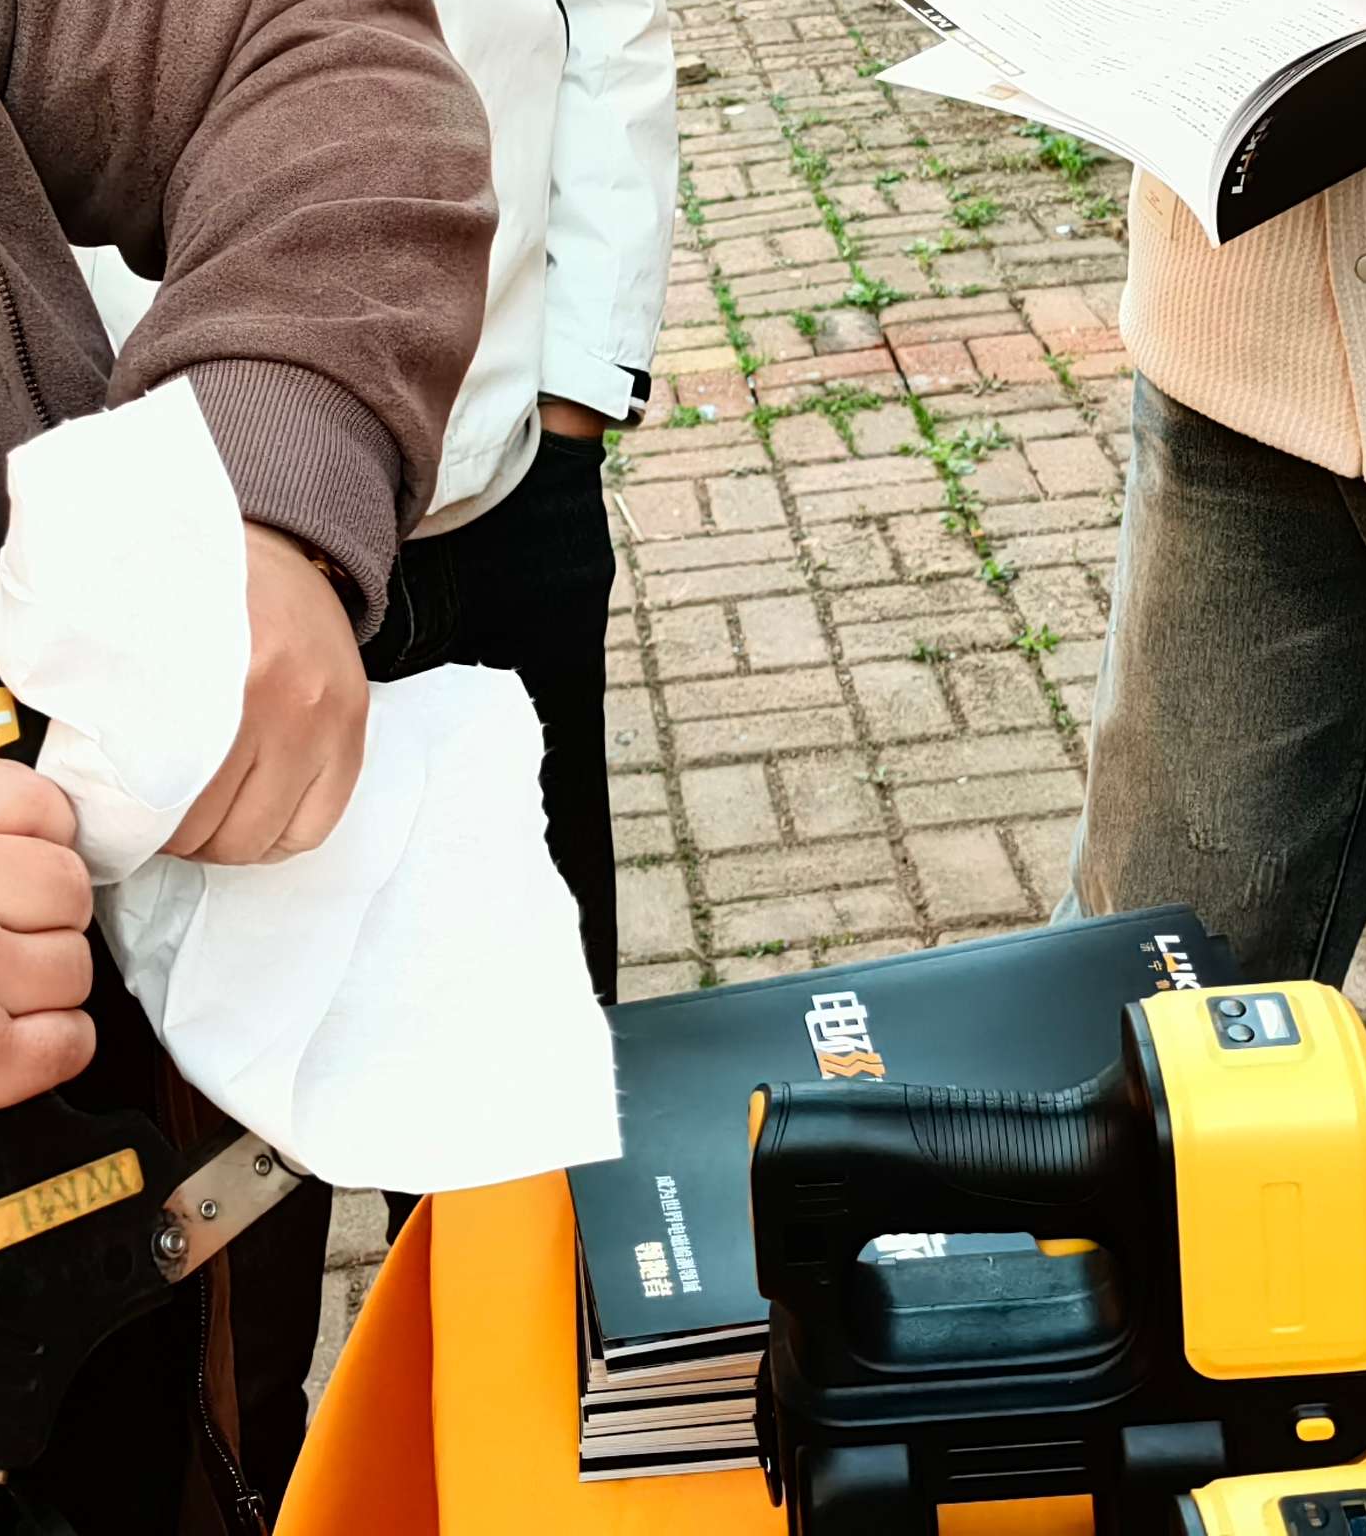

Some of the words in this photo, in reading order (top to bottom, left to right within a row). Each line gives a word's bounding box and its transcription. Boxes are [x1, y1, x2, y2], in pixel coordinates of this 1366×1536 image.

[635, 1241, 673, 1297] 领跑者
[655, 1175, 702, 1293] 成为世界电磁检测领域
